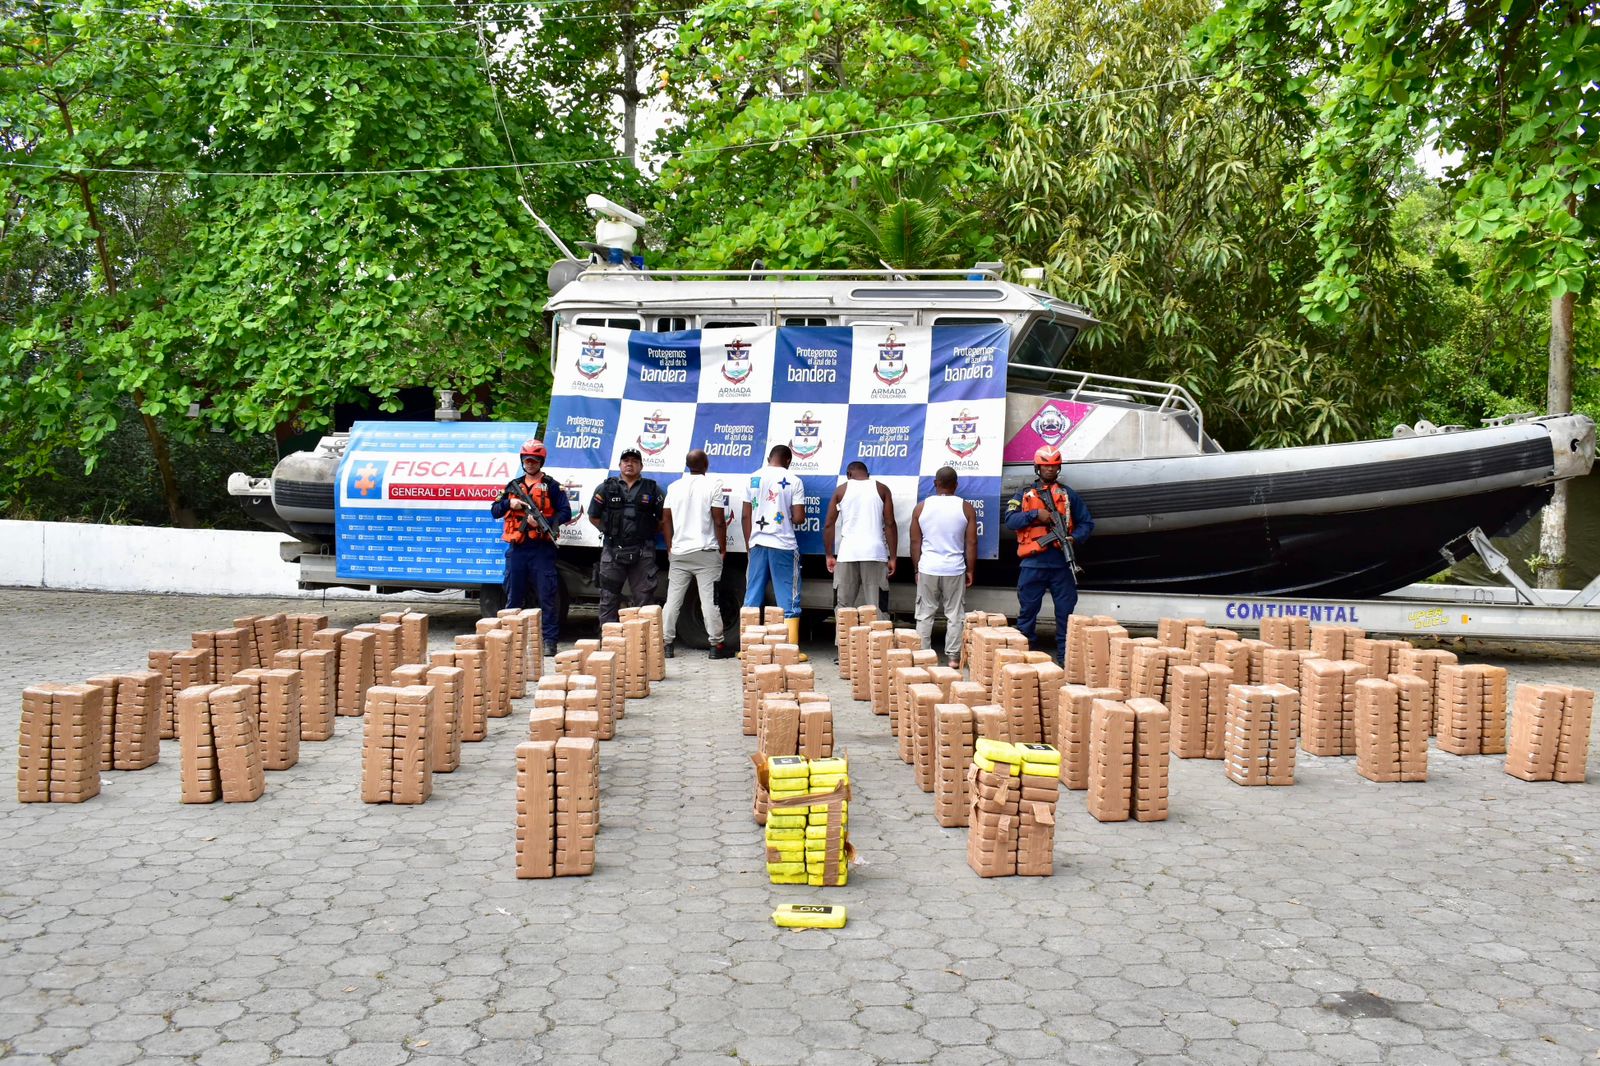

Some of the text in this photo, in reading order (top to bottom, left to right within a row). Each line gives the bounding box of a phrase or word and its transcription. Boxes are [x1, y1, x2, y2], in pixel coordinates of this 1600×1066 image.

[648, 348, 687, 359] Protegemos
[796, 347, 837, 358] Protegemos
[953, 346, 994, 358] Protegemos
[640, 365, 686, 382] bandera
[788, 364, 836, 382] bandera
[945, 364, 993, 381] bandera
[567, 416, 604, 426] Protegemos
[714, 424, 754, 434] Protegemos
[868, 424, 910, 436] Protegemos
[556, 432, 601, 448] bandera
[704, 440, 752, 456] bandera
[858, 441, 908, 457] bandera
[391, 457, 510, 478] FISCALÍA
[392, 487, 436, 496] GENERAL
[438, 488, 452, 496] DE
[454, 488, 466, 497] LA
[1226, 602, 1359, 622] CONTINENTAL
